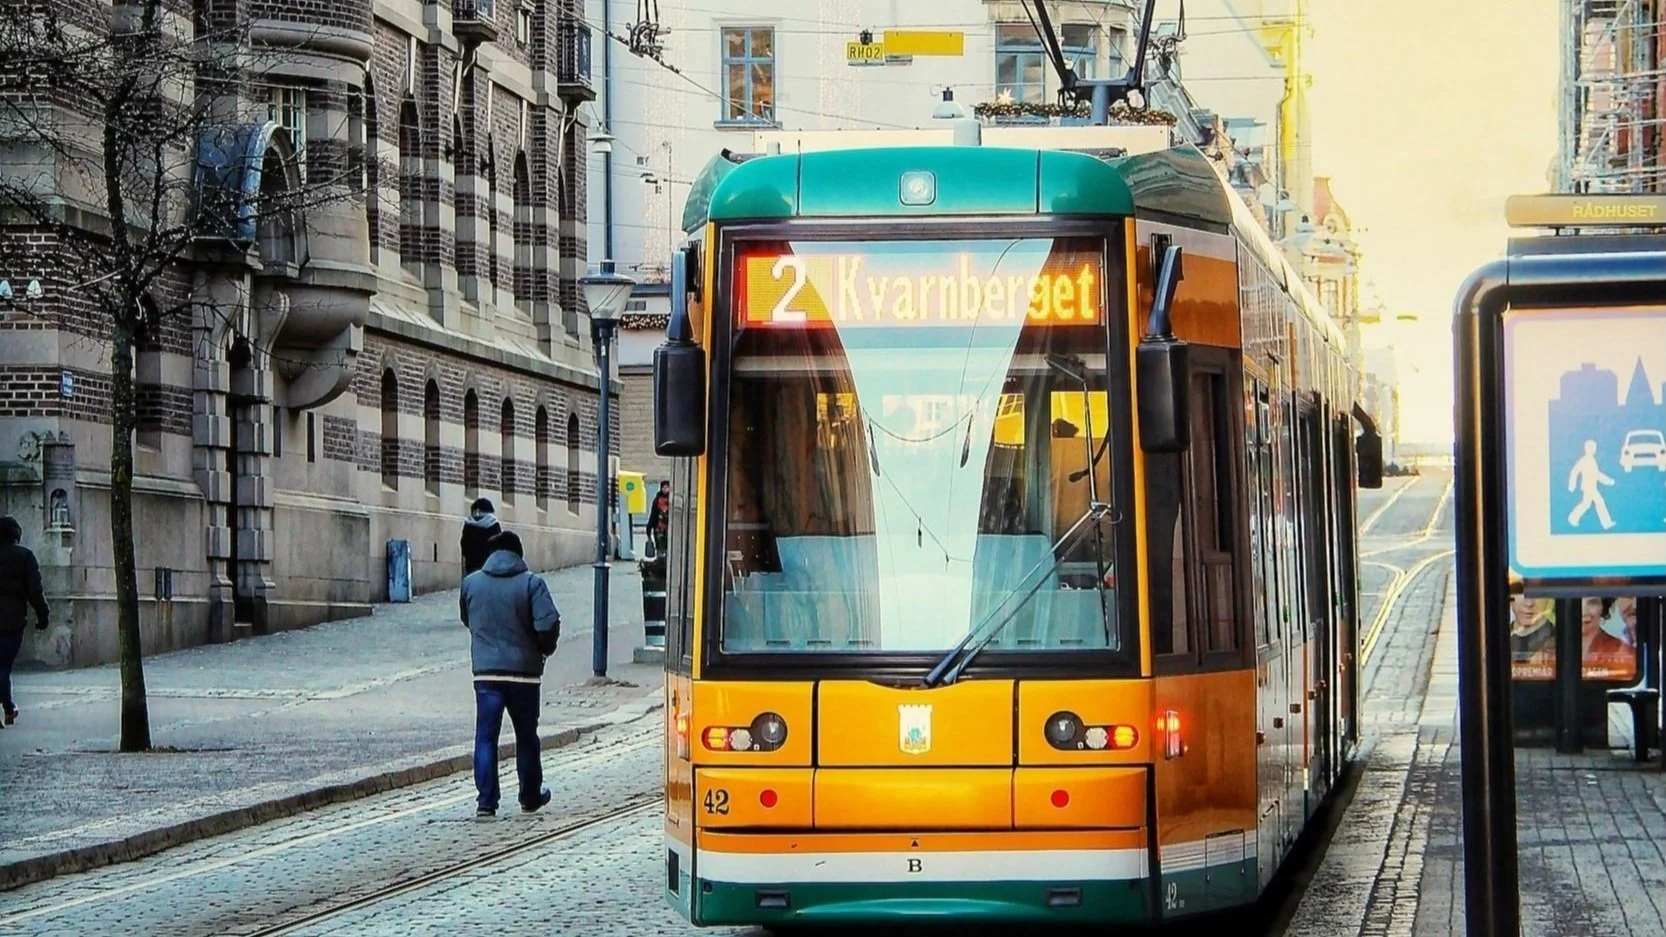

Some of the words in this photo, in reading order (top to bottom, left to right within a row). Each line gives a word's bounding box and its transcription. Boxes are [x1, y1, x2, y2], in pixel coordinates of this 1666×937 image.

[1572, 202, 1658, 218] RÅDHUSET
[770, 255, 809, 322] 2
[837, 252, 1095, 322] Kvarnberget
[703, 788, 730, 816] 42
[906, 858, 923, 873] B
[1165, 882, 1178, 910] 42
